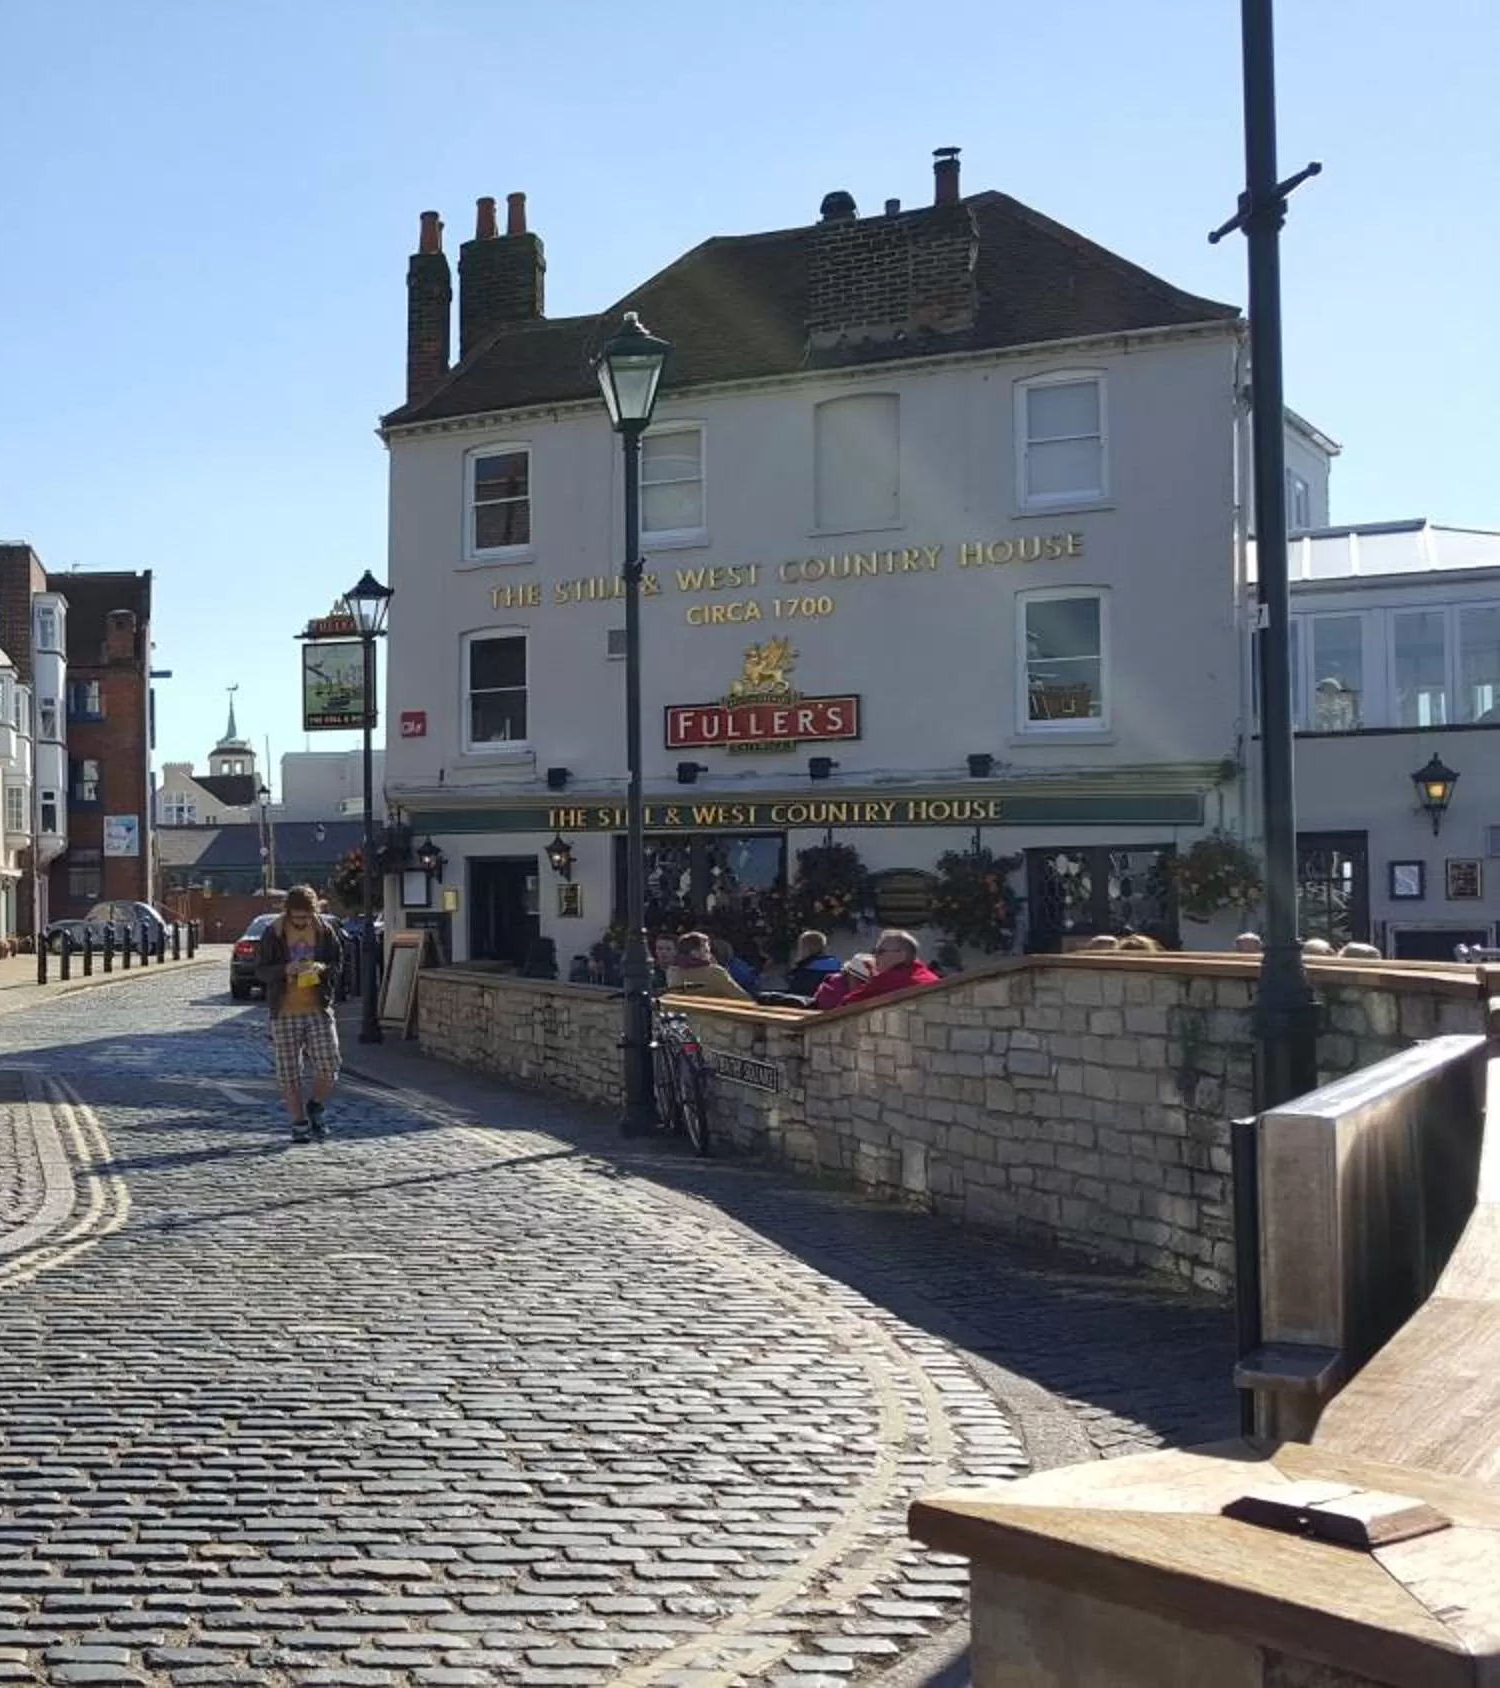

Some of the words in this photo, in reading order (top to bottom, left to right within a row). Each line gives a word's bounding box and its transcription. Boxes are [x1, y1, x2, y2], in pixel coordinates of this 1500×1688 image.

[490, 583, 541, 609] THE
[554, 574, 627, 605] STILL
[640, 574, 662, 596] &
[675, 564, 762, 592] WEST
[778, 544, 944, 584] COUNTRY
[958, 532, 1085, 569] HOUSE
[685, 602, 762, 625] CIRCA
[772, 595, 835, 618] 1700
[677, 703, 843, 739] FULLER'S
[549, 806, 588, 827] THE
[599, 806, 655, 827] STIL
[665, 805, 682, 825] &
[692, 804, 757, 825] WEST
[771, 801, 897, 823] COUNTRY
[907, 799, 1001, 820] HOUSE
